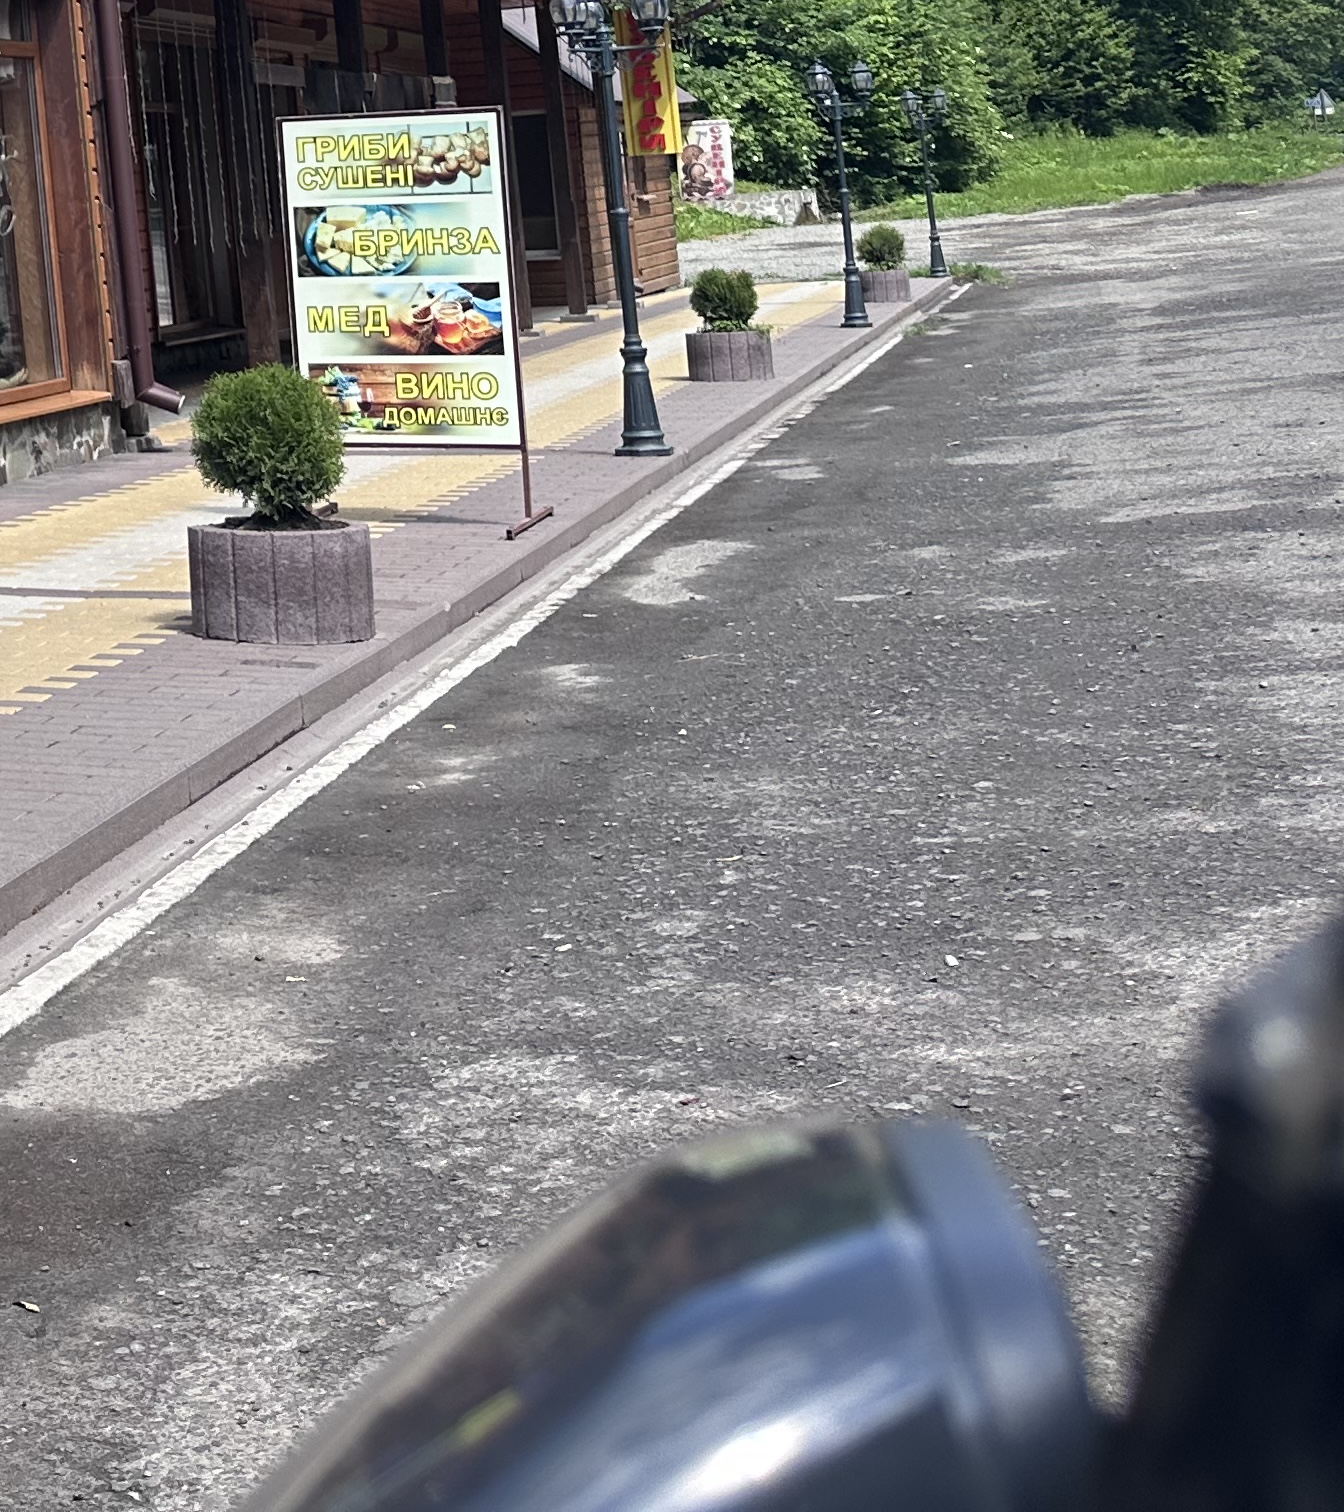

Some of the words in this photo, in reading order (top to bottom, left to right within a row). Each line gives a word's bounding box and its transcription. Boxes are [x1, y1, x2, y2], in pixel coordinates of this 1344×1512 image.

[296, 131, 411, 163] ГРИБИ
[297, 164, 414, 191] СУШЕНІ
[352, 226, 500, 257] БРИНЗА
[307, 305, 390, 337] МЕД
[395, 372, 499, 400] ВИНО
[383, 404, 509, 429] ДОМАШНЄ
